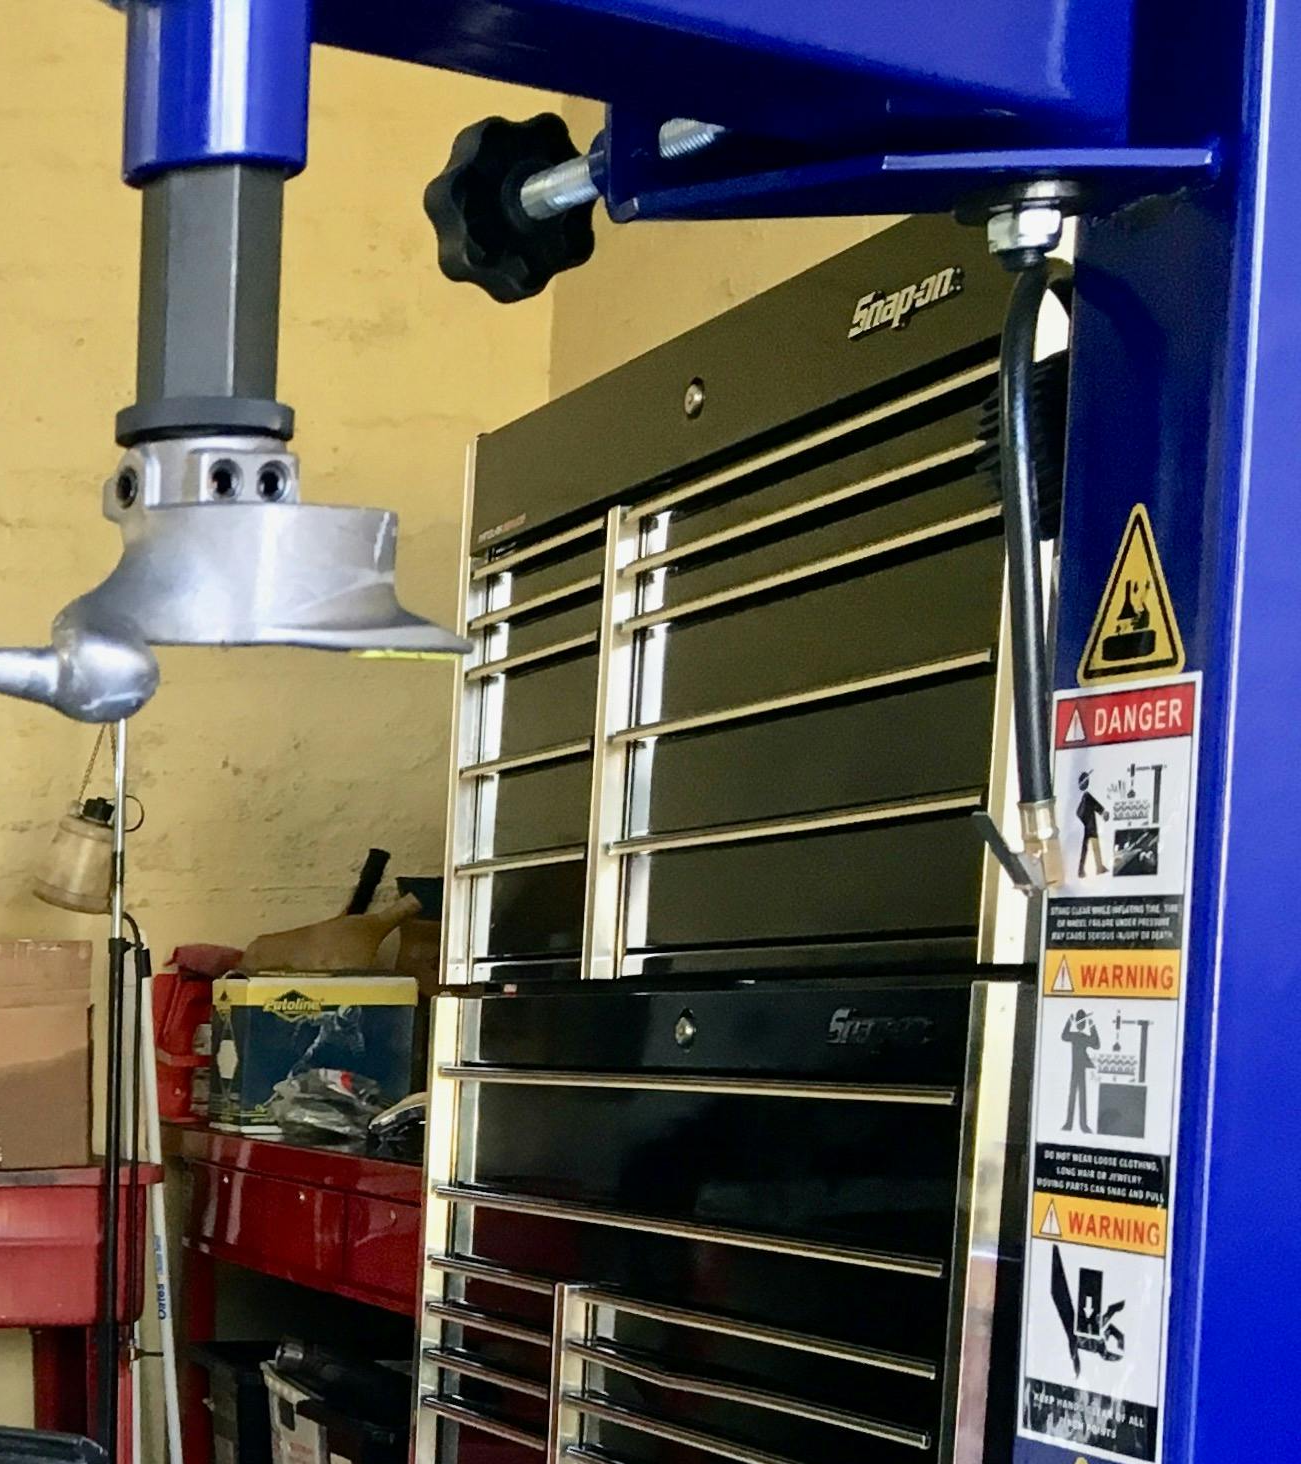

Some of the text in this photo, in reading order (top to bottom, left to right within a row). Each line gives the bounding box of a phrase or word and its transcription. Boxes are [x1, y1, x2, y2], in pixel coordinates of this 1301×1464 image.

[847, 266, 958, 339] Snap-on
[1093, 697, 1184, 738] DANGER
[1080, 962, 1175, 991] WARNING
[1044, 1150, 1054, 1160] DO
[1056, 1152, 1071, 1161] NOT
[1072, 1153, 1093, 1163] WEAR
[1093, 1156, 1117, 1167] LOOSE
[1056, 1167, 1076, 1177] LONG
[1077, 1170, 1095, 1179] HAIR
[1096, 1171, 1107, 1180] OR
[1065, 1181, 1088, 1192] PARTS
[1090, 1184, 1105, 1194] CAN
[1107, 1186, 1127, 1197] SNAG
[1128, 1188, 1144, 1200] AND
[1067, 1210, 1161, 1247] WARNING
[1129, 1415, 1145, 1428] ALL
